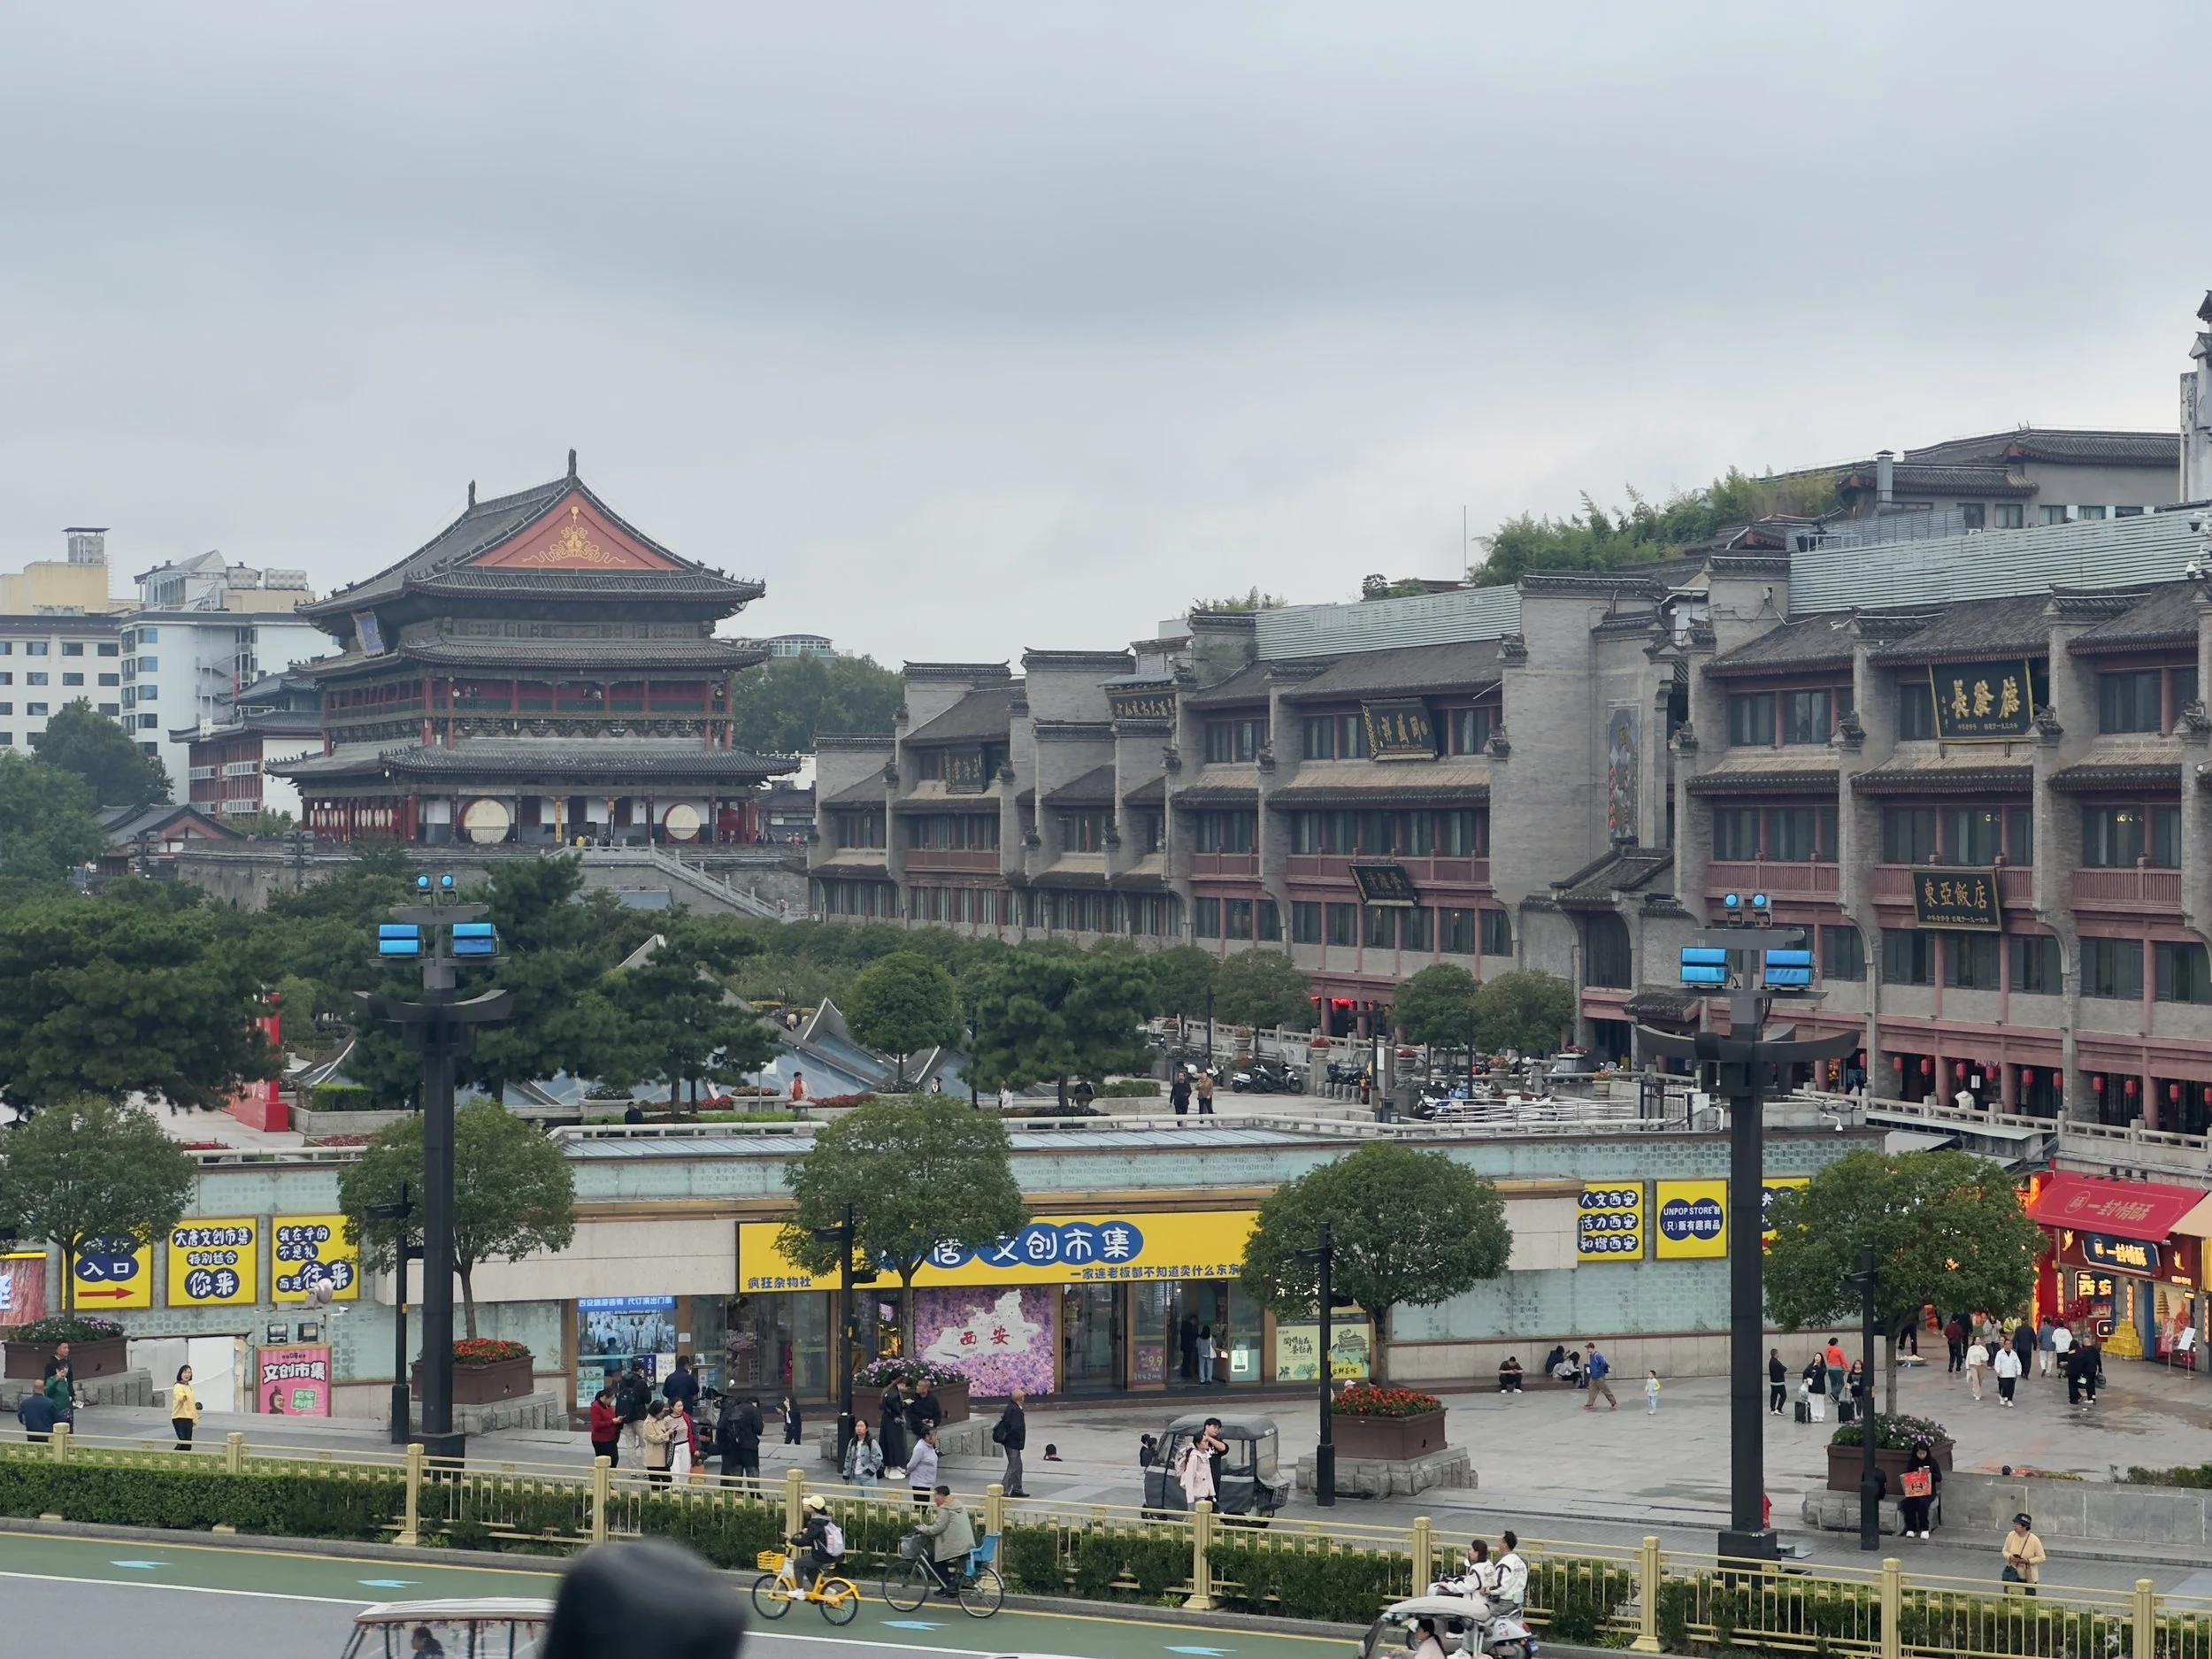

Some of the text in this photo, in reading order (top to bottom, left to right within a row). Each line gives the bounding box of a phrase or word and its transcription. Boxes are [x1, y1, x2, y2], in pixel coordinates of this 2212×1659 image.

[1925, 879, 1987, 910] 東亞飯店
[1581, 1192, 1637, 1208] 人文西安
[1663, 1207, 1688, 1216] UNPOP
[1581, 1213, 1637, 1230] 活力西安
[174, 1226, 250, 1247] 大唐文创市集
[279, 1225, 328, 1241] 我在乎的
[1580, 1235, 1637, 1251] 和谐西安
[188, 1252, 238, 1266] 特别适合
[279, 1244, 315, 1260] 不是礼
[82, 1262, 130, 1277] 入口
[279, 1260, 350, 1290] 而是往来
[189, 1269, 235, 1297] 你来
[748, 1275, 811, 1289] 疯狂杂物社
[960, 1325, 1010, 1346] 西安
[263, 1362, 326, 1385] 文创市集
